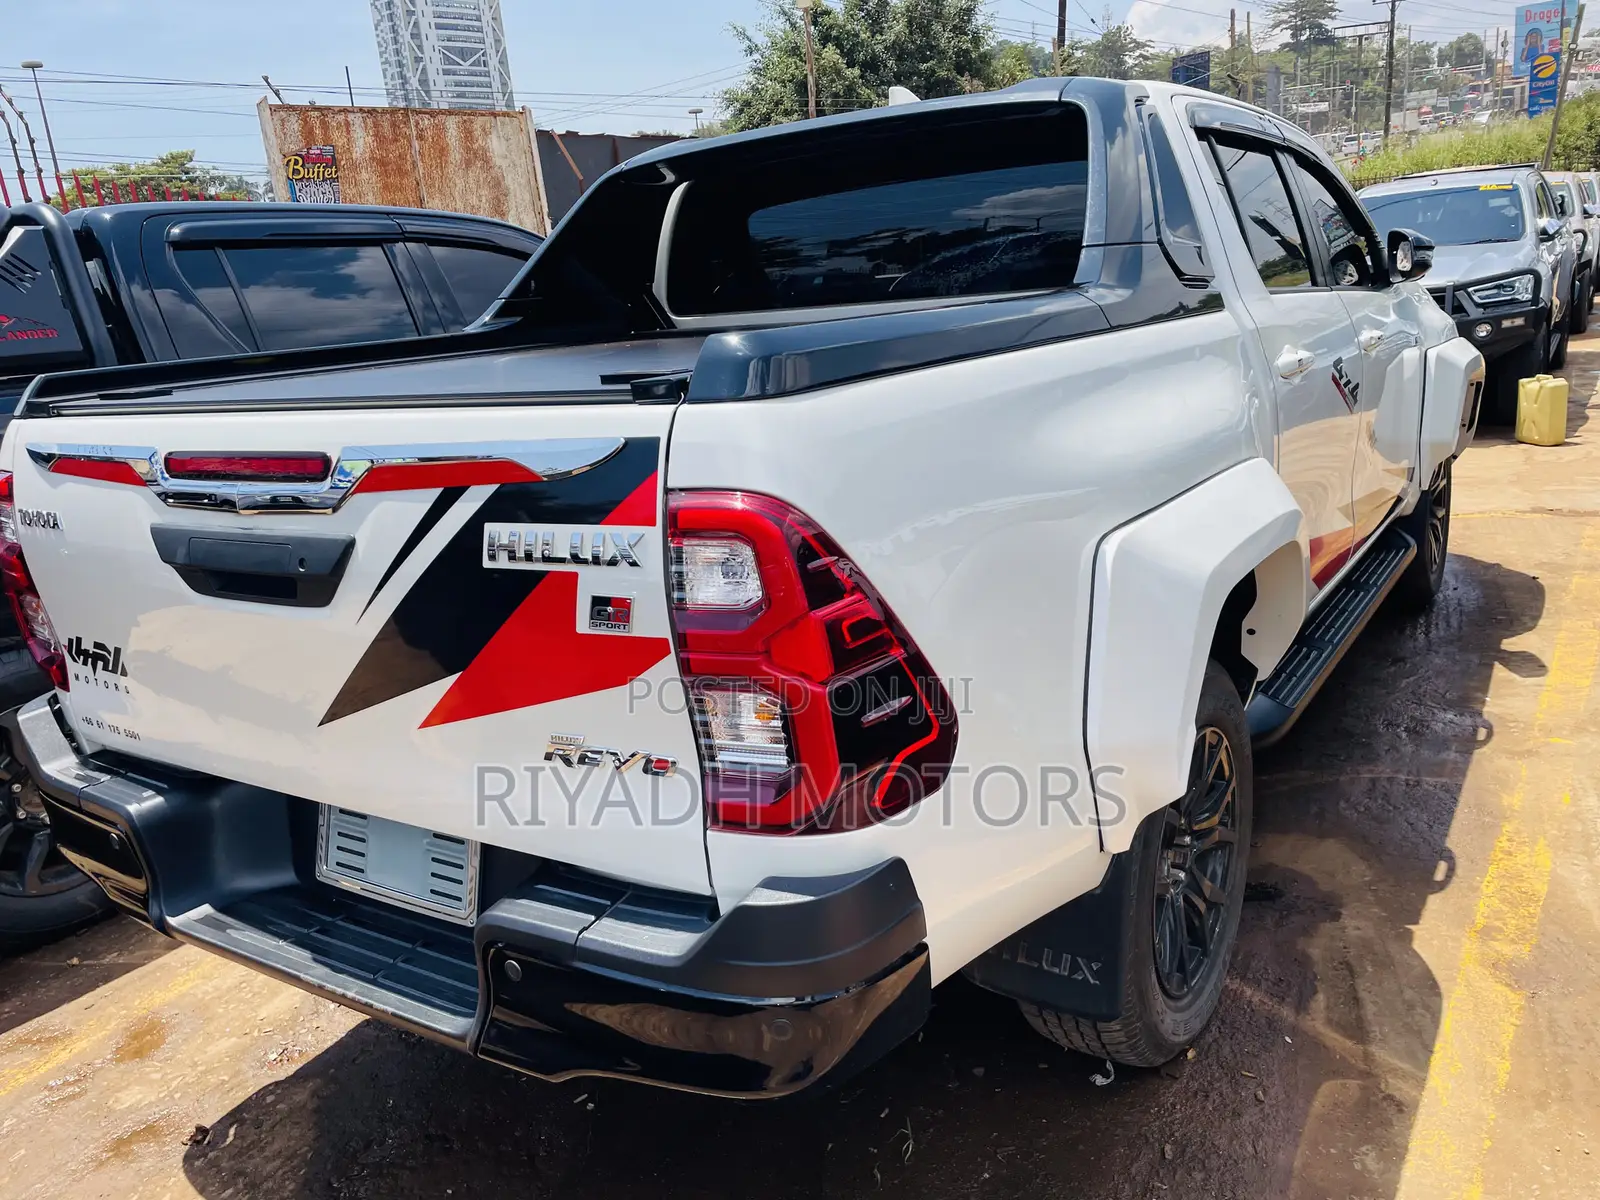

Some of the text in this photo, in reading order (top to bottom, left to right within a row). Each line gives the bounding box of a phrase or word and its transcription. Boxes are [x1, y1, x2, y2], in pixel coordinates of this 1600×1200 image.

[284, 156, 338, 180] Buffet
[18, 508, 63, 531] TOYOTA
[487, 529, 645, 568] HILUX
[592, 606, 629, 622] GR
[591, 621, 629, 631] SPORT
[74, 673, 130, 695] MOTORS
[108, 724, 121, 735] 175
[124, 728, 141, 742] 5501
[544, 743, 679, 777] REVO
